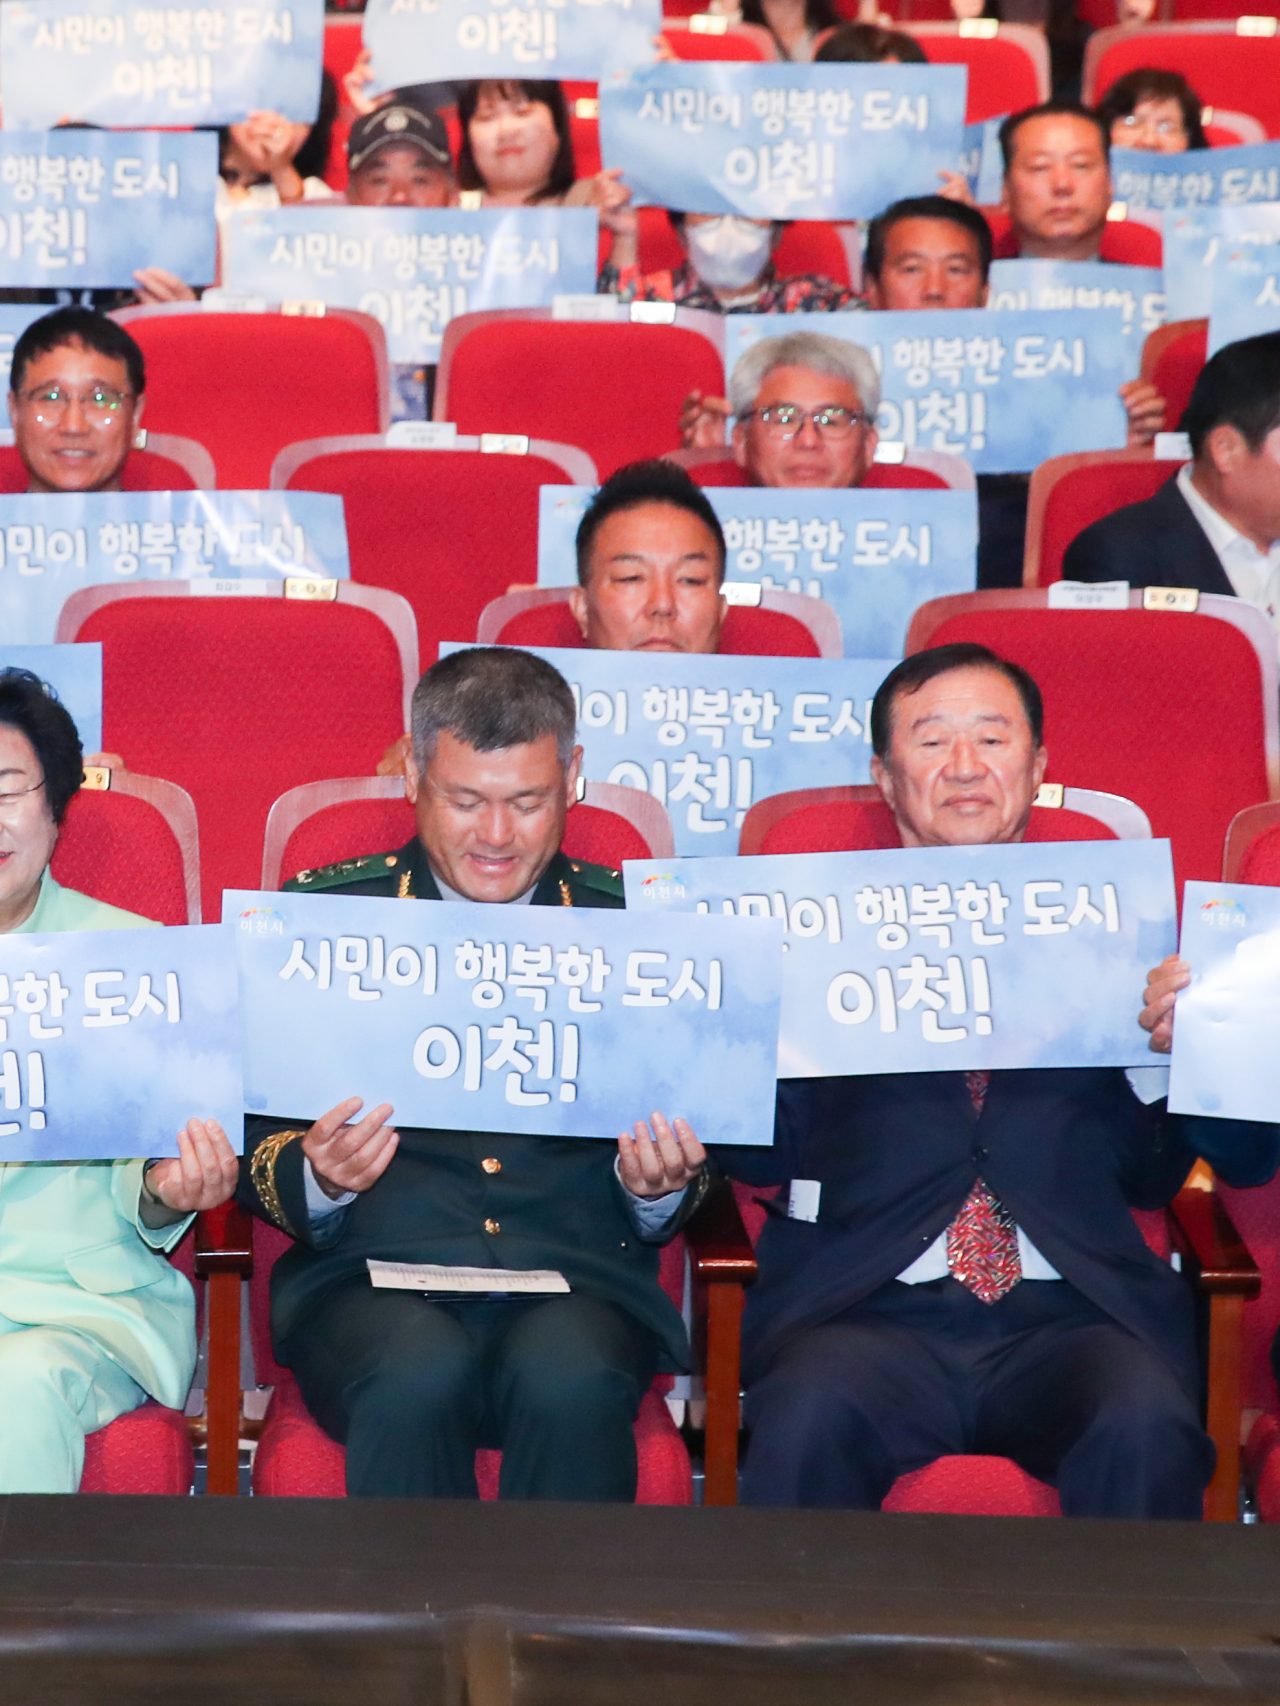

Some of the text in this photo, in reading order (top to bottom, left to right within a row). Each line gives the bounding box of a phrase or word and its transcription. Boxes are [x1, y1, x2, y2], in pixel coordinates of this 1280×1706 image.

[34, 8, 294, 53] 시민이 행복한 도시
[458, 7, 558, 62] 이천!
[112, 54, 213, 108] 이천!
[638, 87, 930, 136] 시민이 행복한 도시
[1, 153, 105, 204] 행복한
[111, 157, 179, 199] 도시
[723, 138, 837, 199] 이천!
[269, 233, 560, 281] 시민이 행복한 도시
[892, 338, 1004, 387] 행복한
[1012, 335, 1086, 379] 도시
[874, 390, 986, 455] 이천!
[98, 522, 218, 576] 행복한
[723, 516, 932, 574] 행복한 도시
[642, 684, 780, 749] 행복한
[790, 692, 871, 744] 도시
[96, 773, 103, 784] 9
[239, 918, 284, 936] 이천시
[854, 881, 1011, 952] 행복한
[1022, 880, 1121, 936] 도시
[82, 970, 182, 1026] 도시
[278, 936, 722, 1014] 시민이 행복한 도시
[825, 954, 995, 1044] 이천!
[412, 1015, 581, 1108] 이천!
